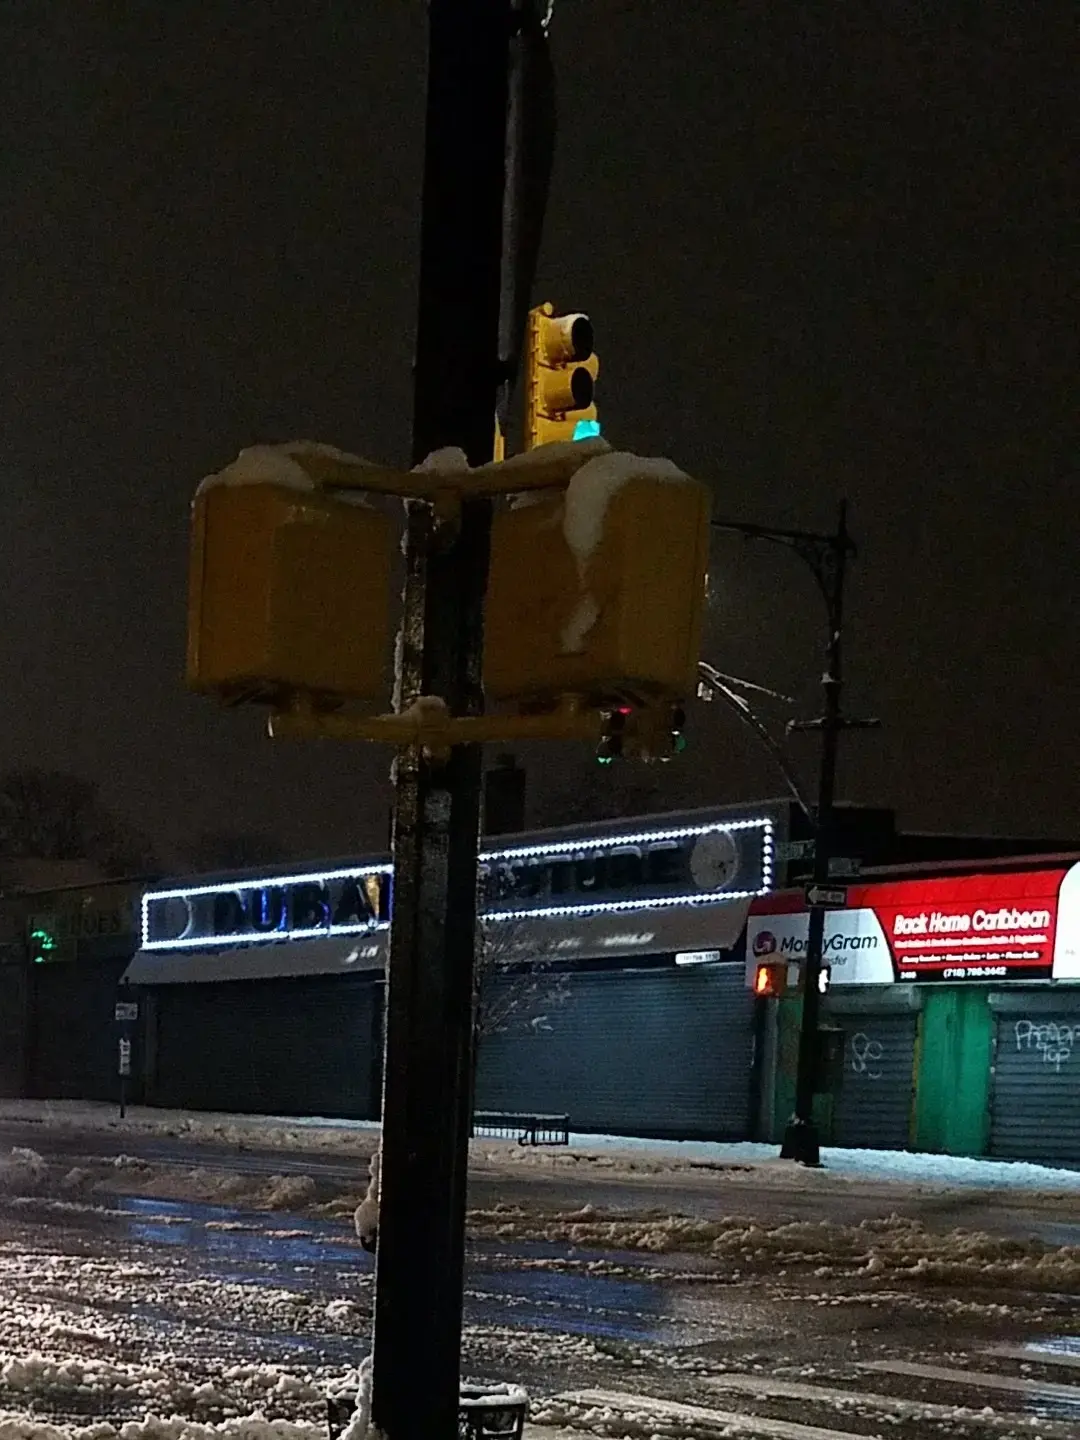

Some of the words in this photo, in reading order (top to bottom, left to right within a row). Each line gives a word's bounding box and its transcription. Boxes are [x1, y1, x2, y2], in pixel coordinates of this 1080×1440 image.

[893, 912, 929, 935] Back
[929, 911, 970, 933] Home
[973, 908, 1050, 931] Caribbean
